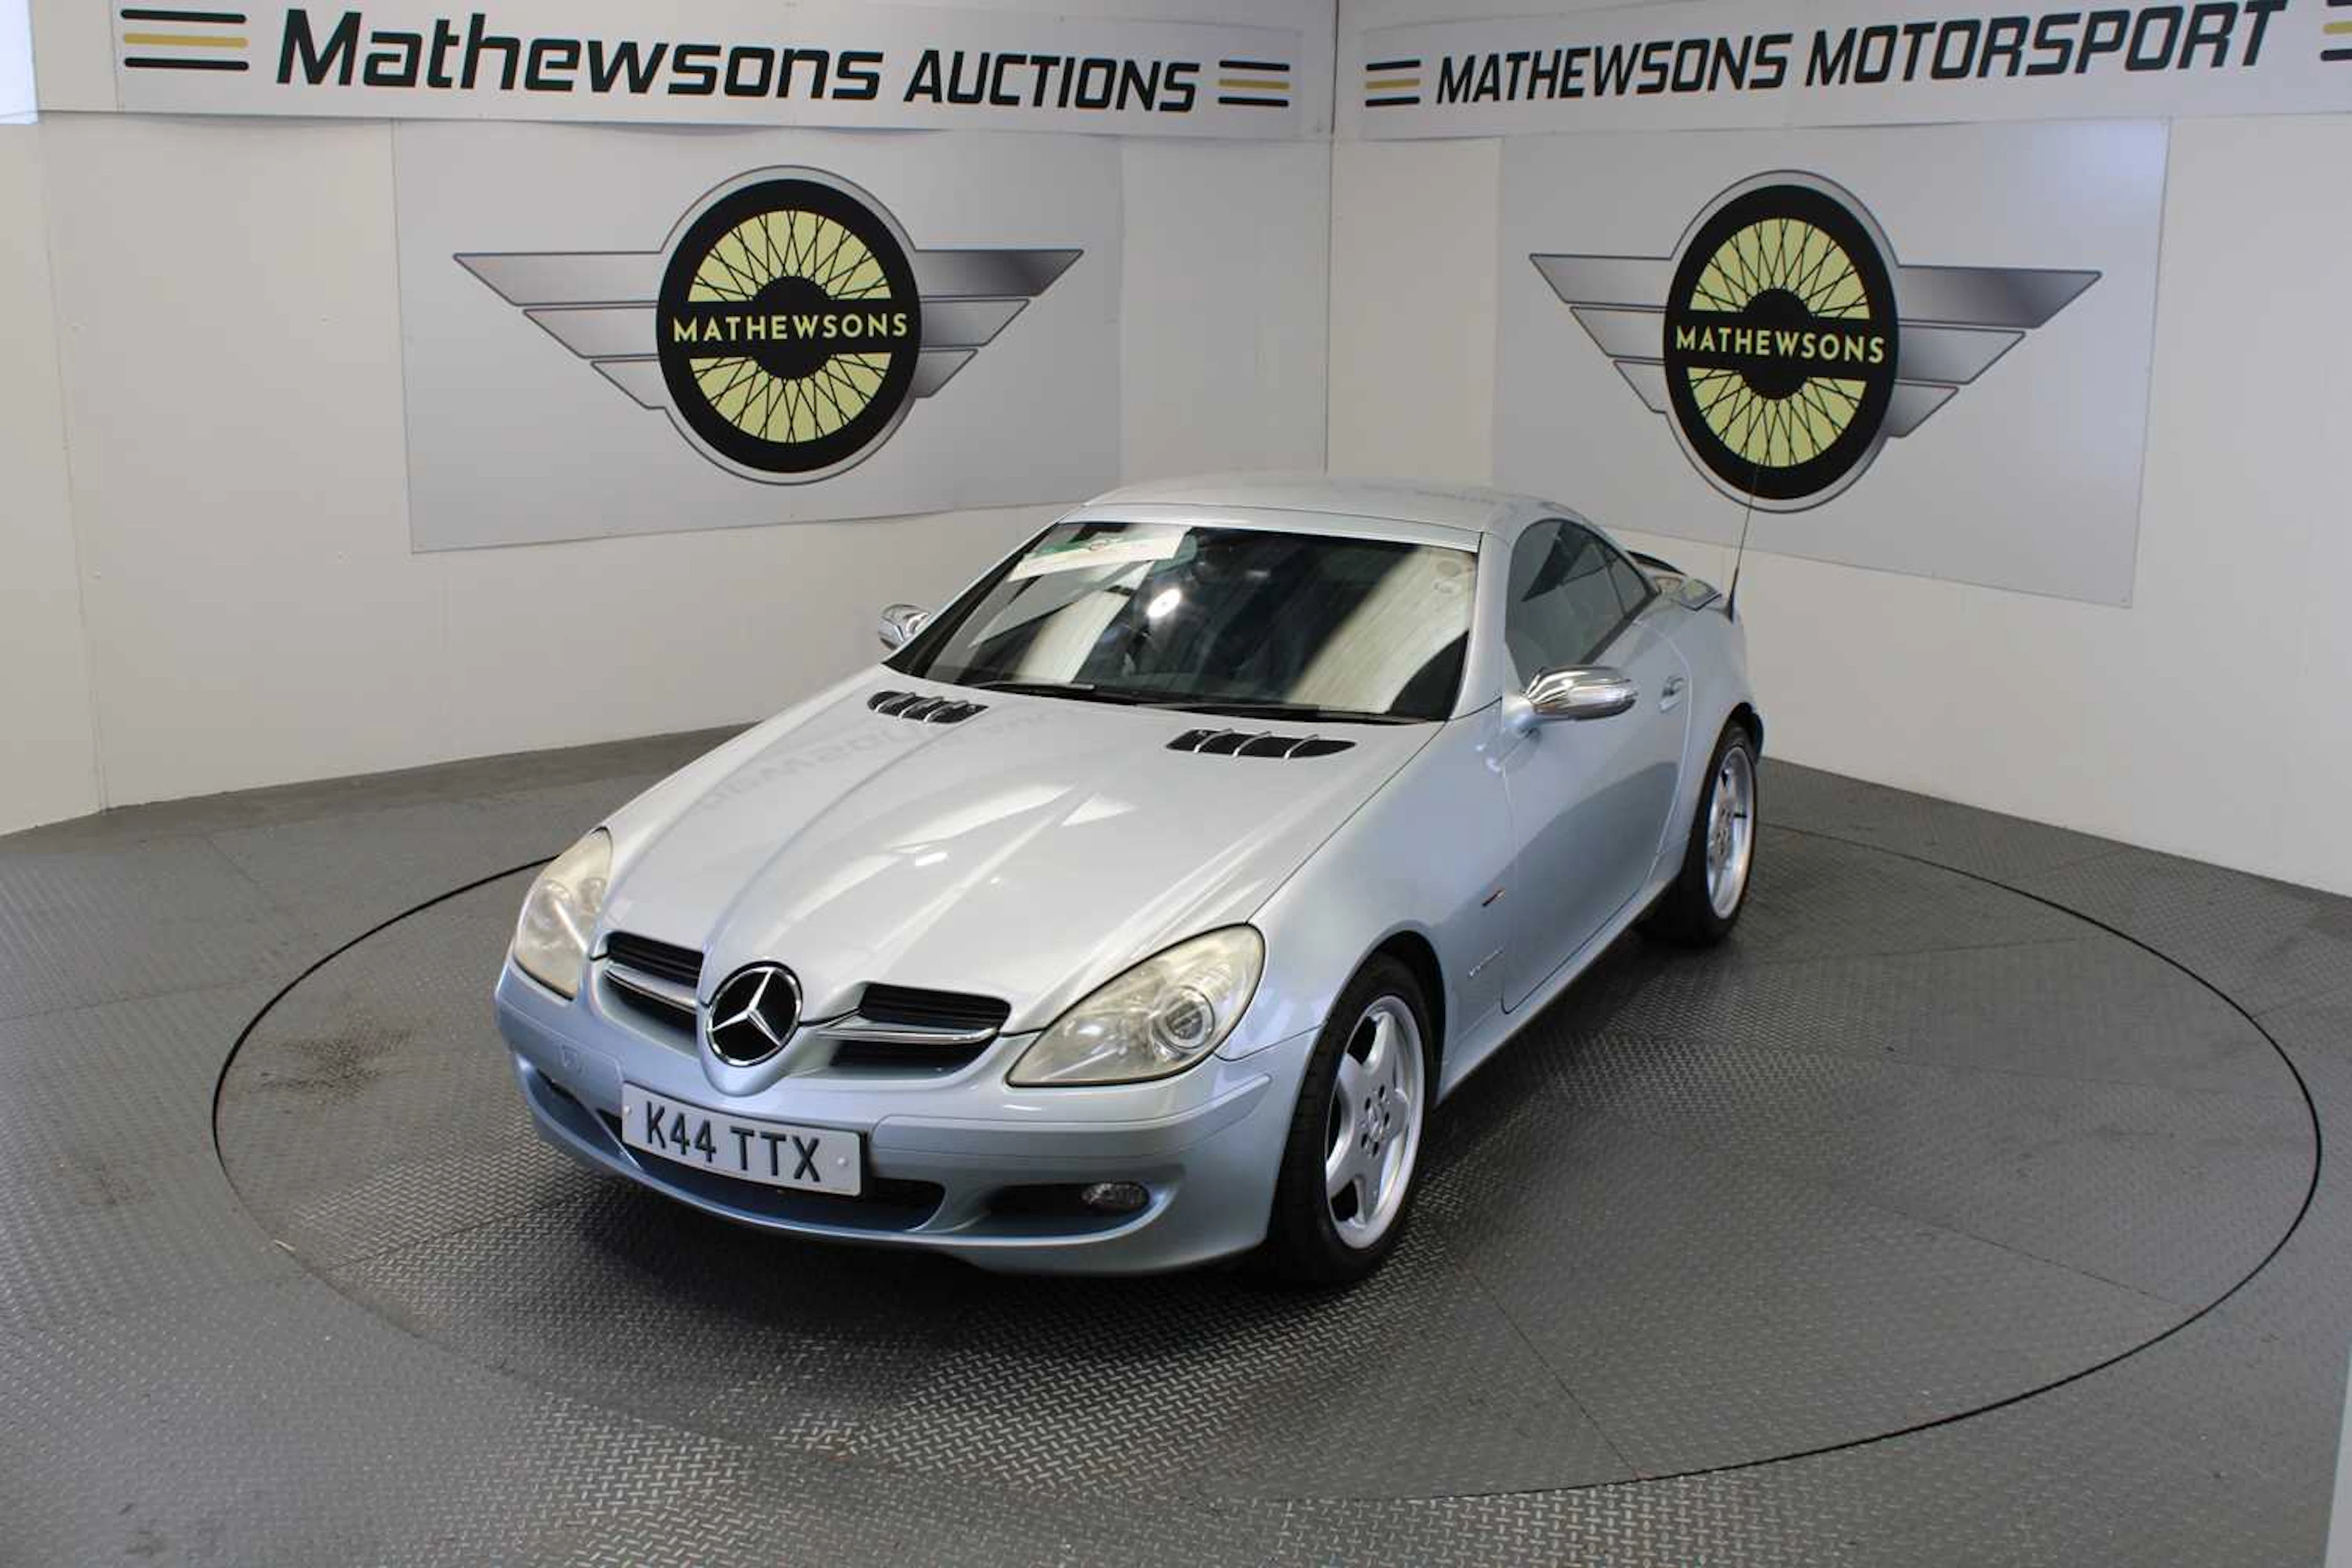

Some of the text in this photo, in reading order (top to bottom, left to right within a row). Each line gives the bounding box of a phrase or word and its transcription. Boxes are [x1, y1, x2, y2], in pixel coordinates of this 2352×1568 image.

[276, 9, 1201, 113] Mathewsons AUCTIONS
[1436, 0, 2288, 105] MATHEWSONS MOTORSPORT
[674, 313, 907, 342] MATHEWSONS
[1676, 326, 1883, 363] MATHEWSONS
[646, 1101, 821, 1183] K44 TTX
